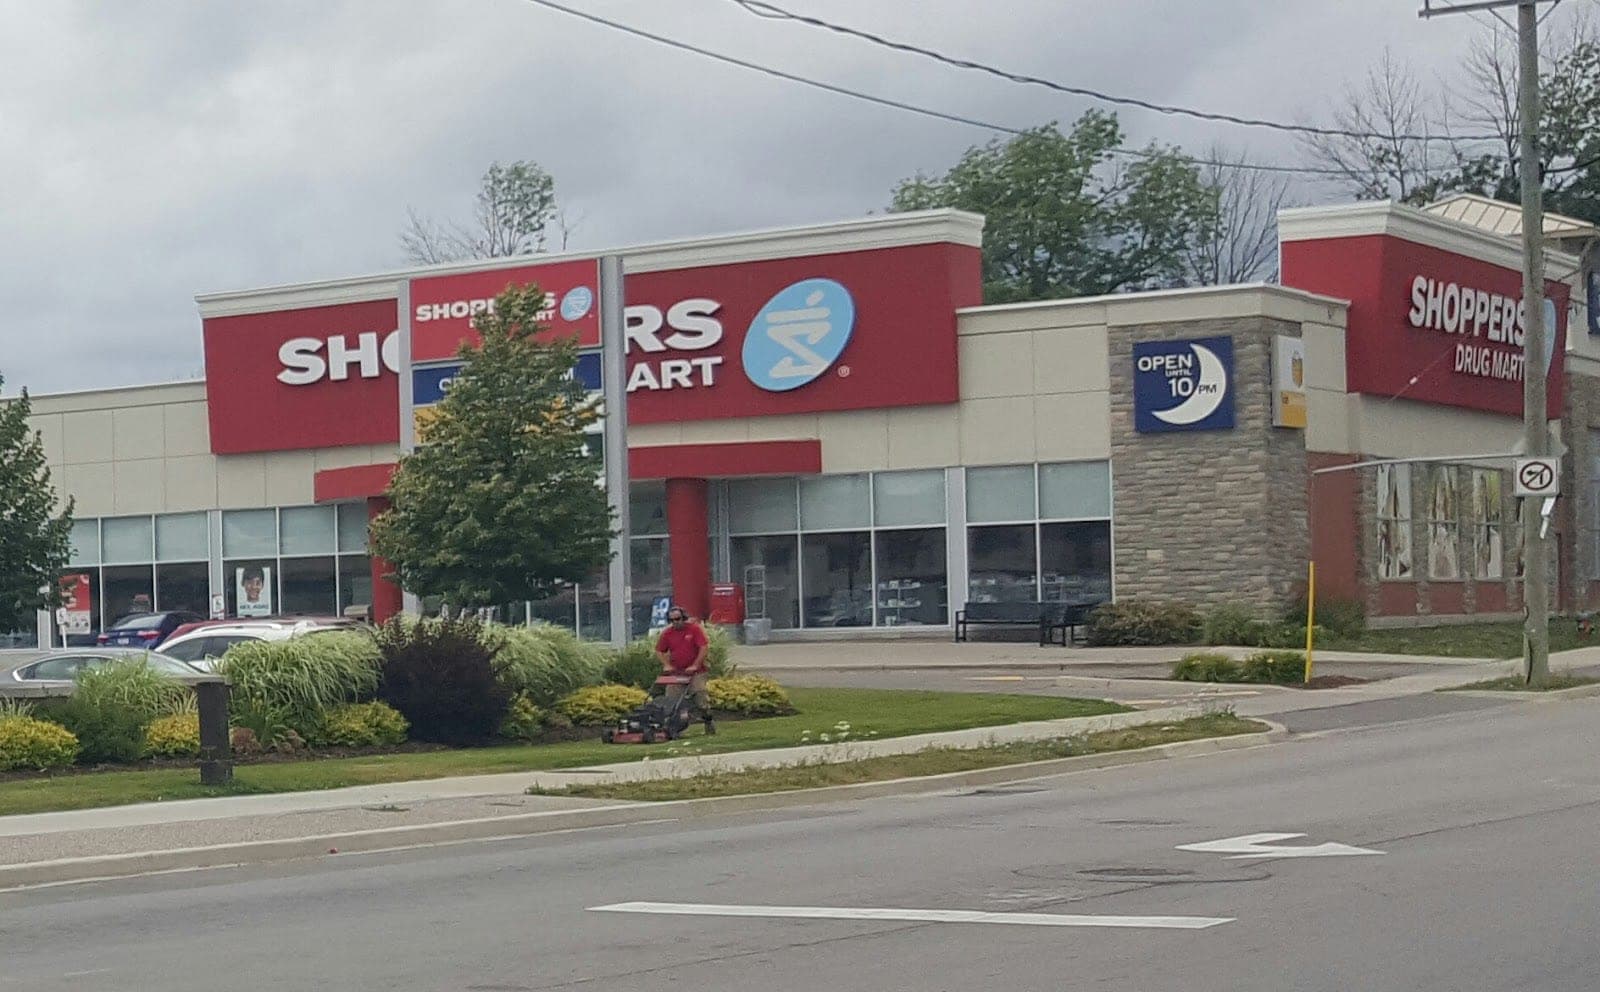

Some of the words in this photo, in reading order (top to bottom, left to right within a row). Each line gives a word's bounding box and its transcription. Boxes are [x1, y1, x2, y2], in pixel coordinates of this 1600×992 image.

[1409, 275, 1525, 347] SHOPPERS
[626, 356, 723, 392] ART
[1138, 353, 1193, 371] OPEN
[1165, 368, 1193, 377] UNTIL
[1455, 343, 1490, 376] DRUG
[1491, 349, 1525, 381] MART
[1168, 376, 1194, 397] 10
[1198, 384, 1217, 395] PM
